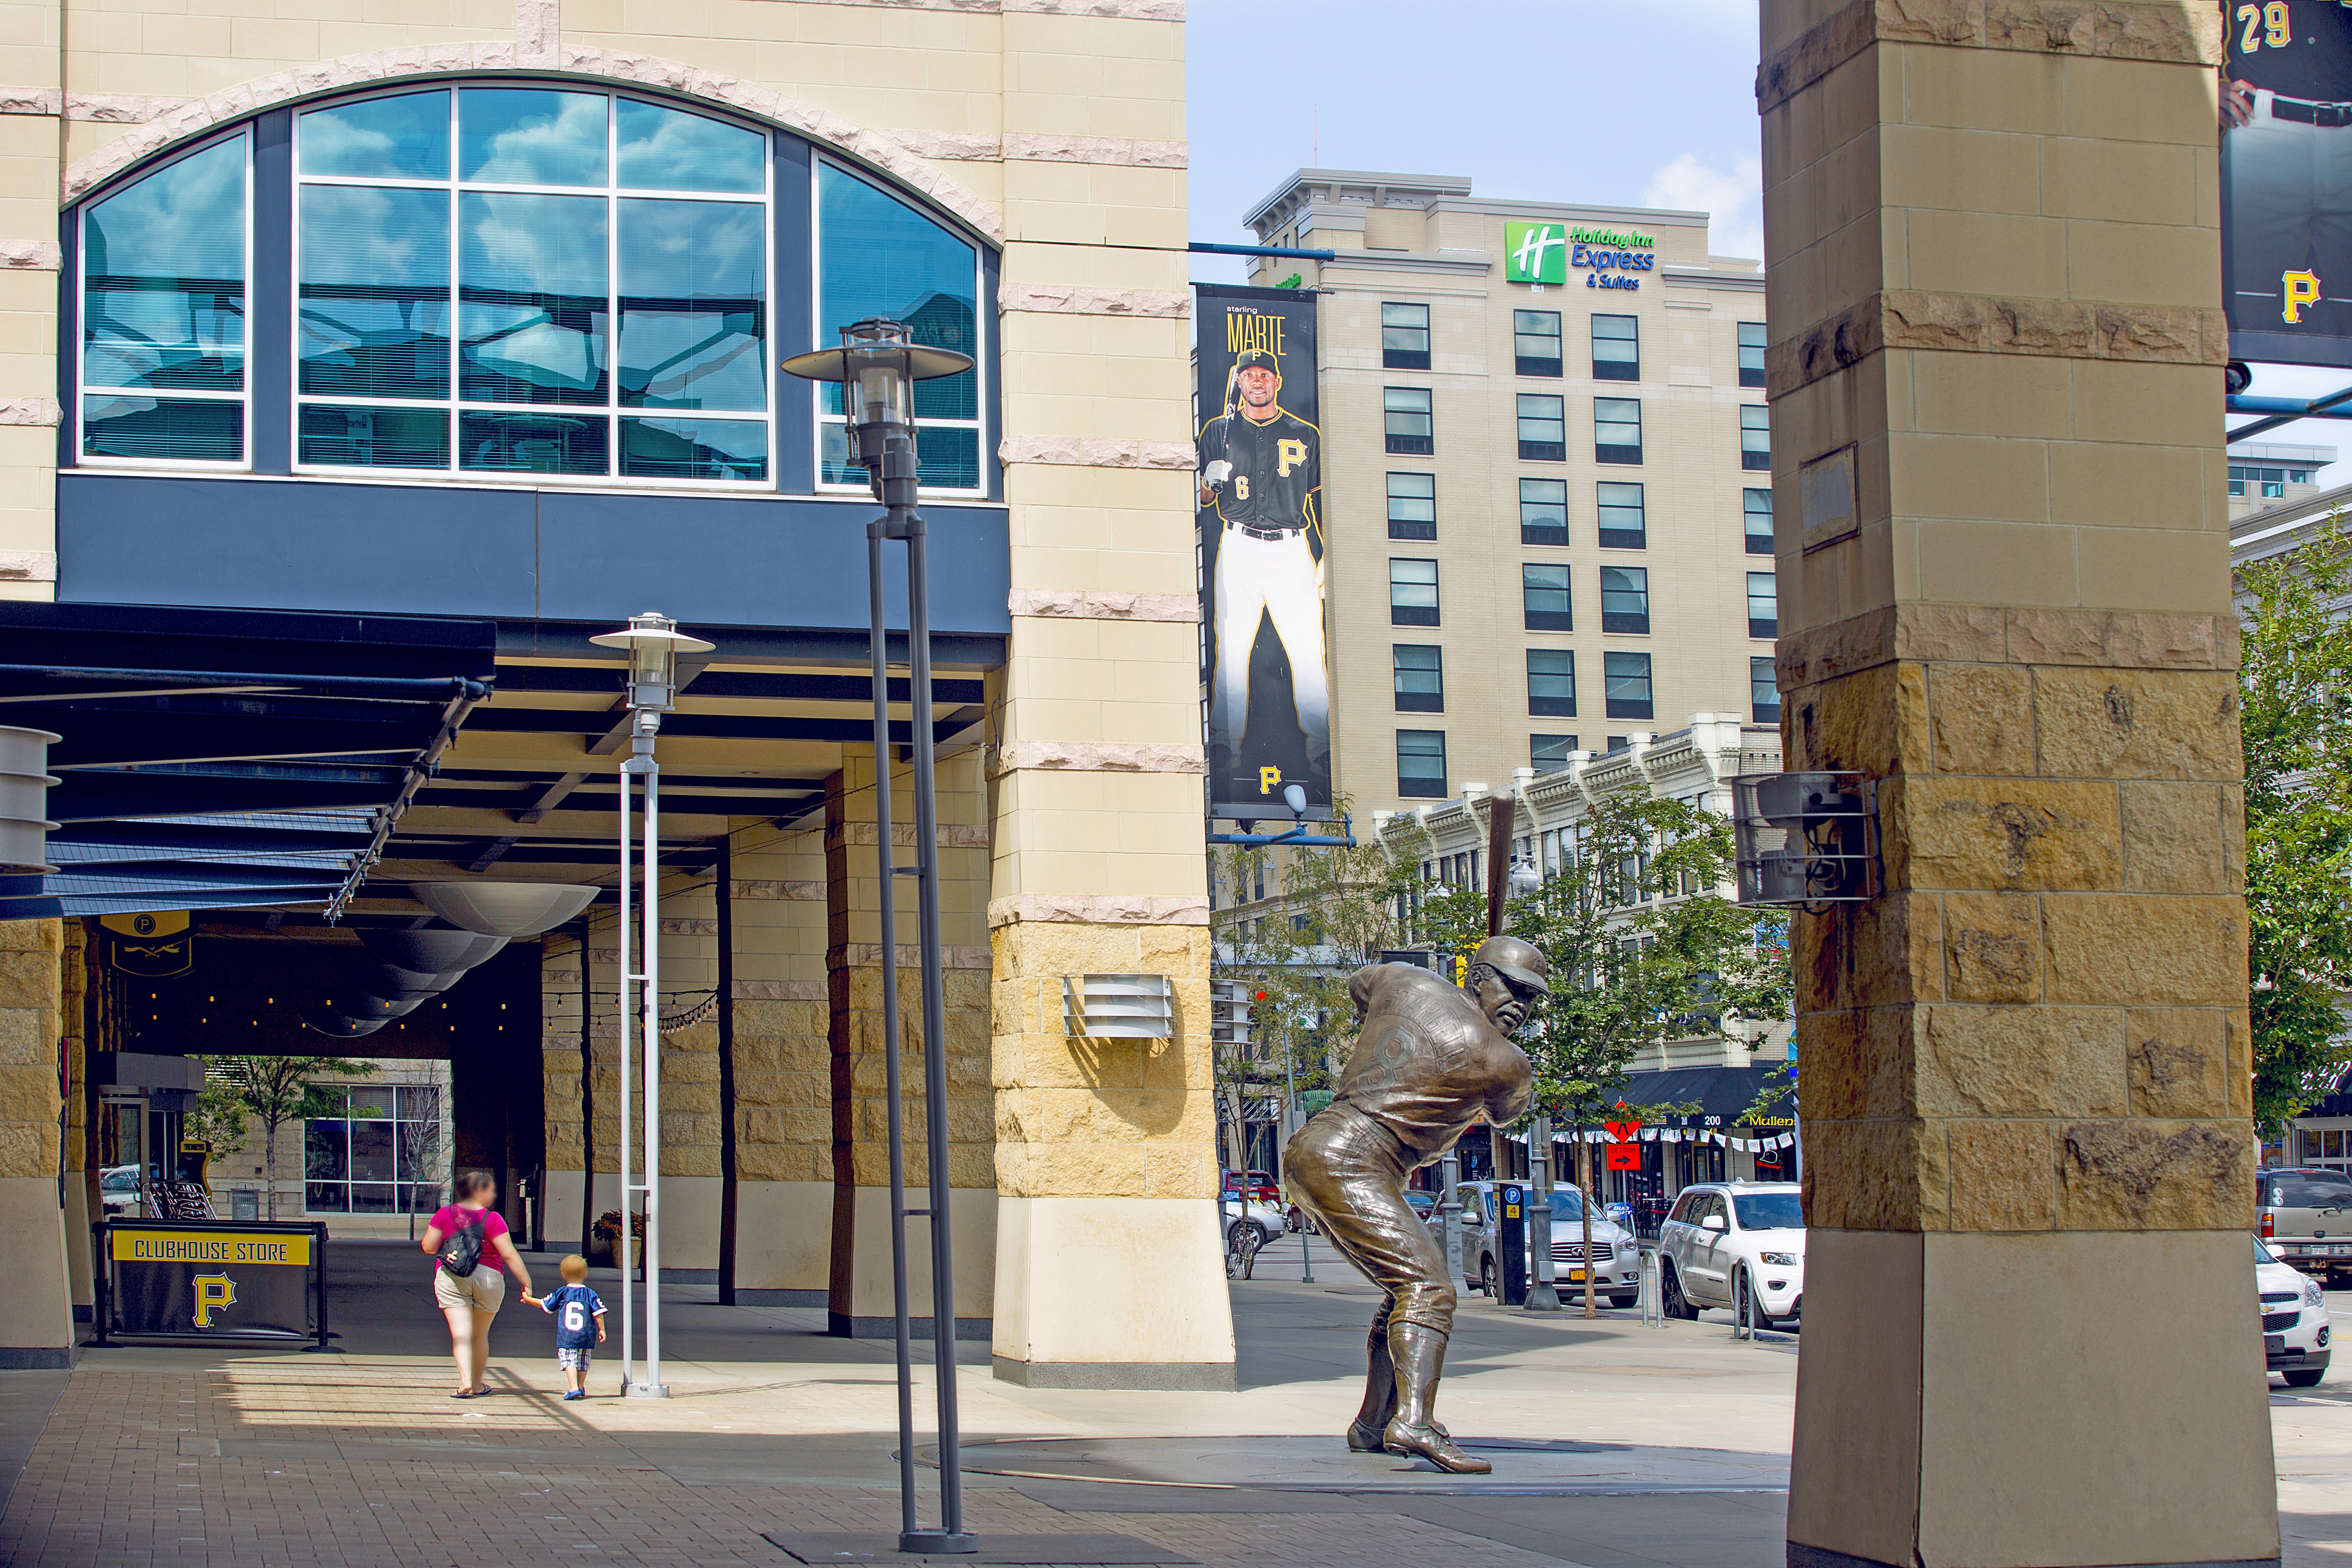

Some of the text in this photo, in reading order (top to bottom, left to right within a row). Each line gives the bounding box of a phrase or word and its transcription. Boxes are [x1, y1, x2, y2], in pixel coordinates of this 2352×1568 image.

[2236, 1, 2291, 54] 29
[1570, 226, 1655, 249] Holiday Inn
[1571, 244, 1655, 273] Express
[1586, 274, 1640, 290] & Suites
[2281, 268, 2322, 324] P
[1227, 306, 1258, 314] starling
[1227, 313, 1287, 356] MARTE
[1252, 350, 1261, 361] P
[1276, 438, 1307, 477] P
[1235, 476, 1249, 500] 6
[1259, 765, 1282, 794] P
[1357, 1026, 1416, 1100] 8
[1704, 1116, 1721, 1125] 200
[135, 1240, 288, 1261] CLUBHOUSE STORE
[193, 1272, 237, 1327] P
[565, 1301, 584, 1331] 6
